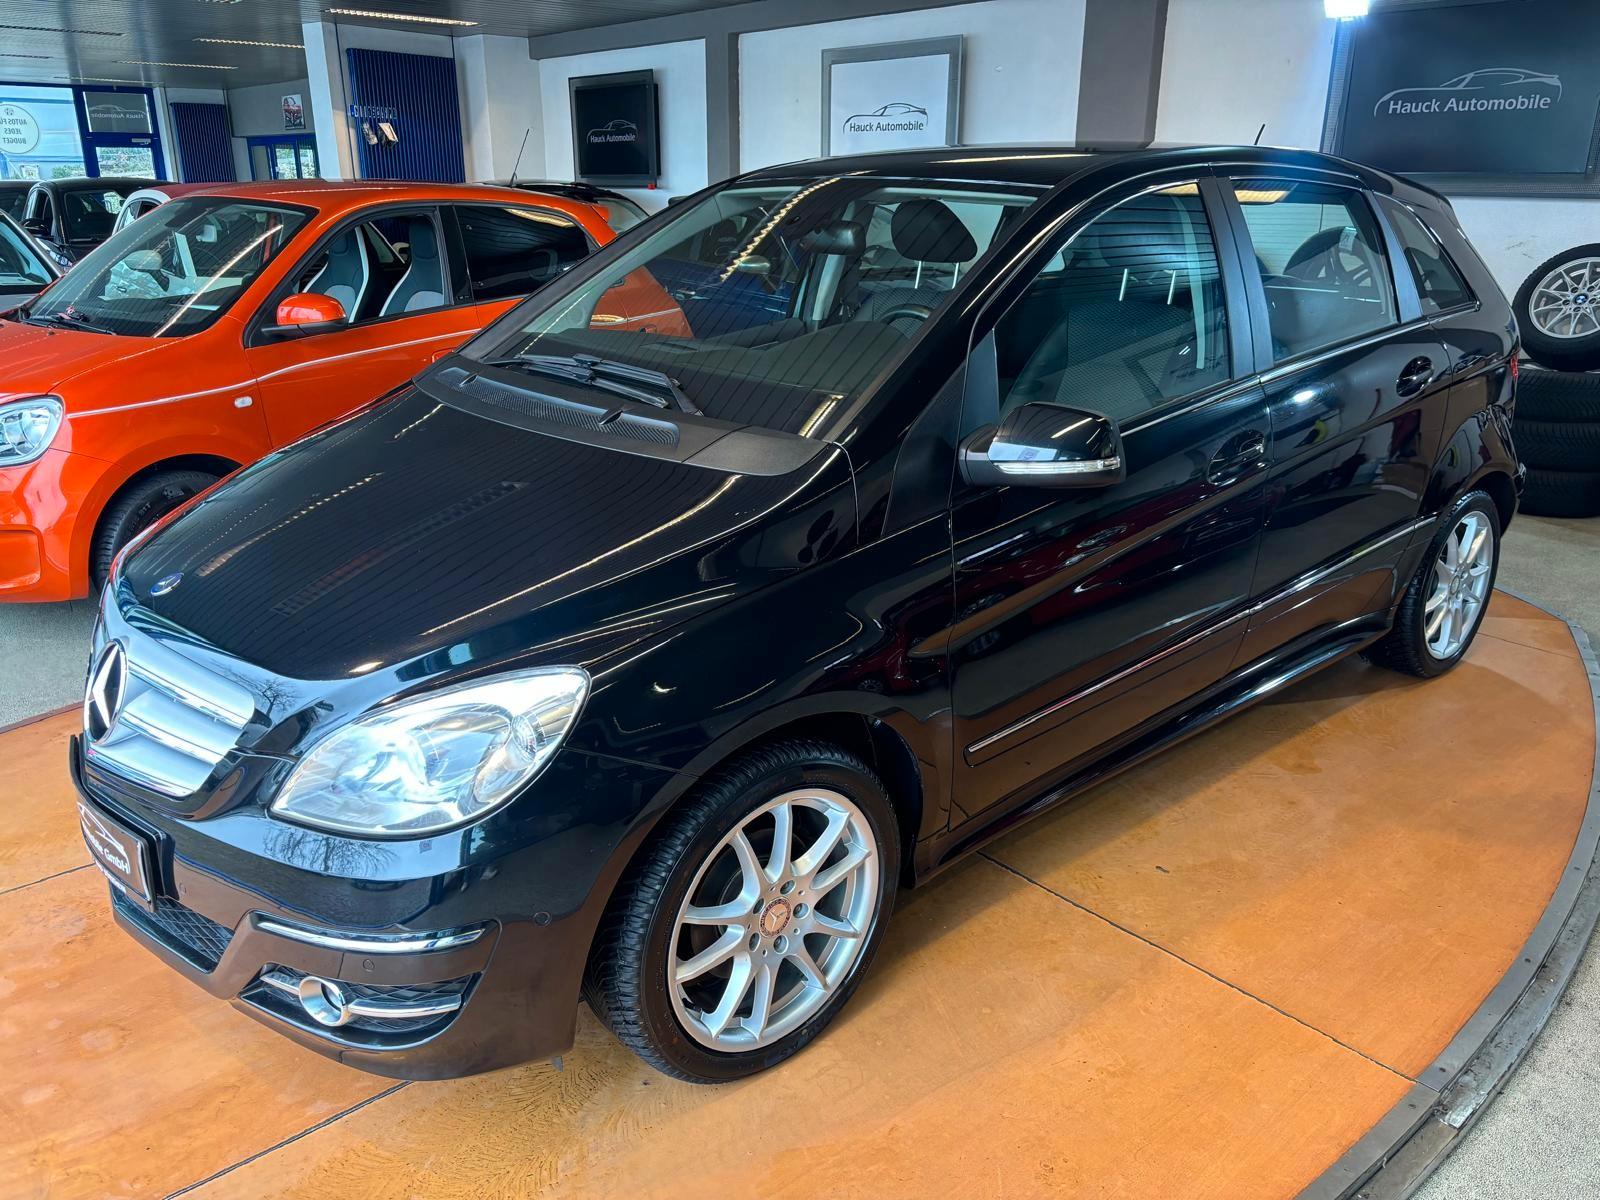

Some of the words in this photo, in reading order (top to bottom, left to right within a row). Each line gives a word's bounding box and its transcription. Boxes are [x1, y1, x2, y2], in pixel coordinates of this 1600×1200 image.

[1388, 98, 1440, 114] Hauck
[1443, 94, 1551, 112] Automobile
[849, 122, 874, 132] Hauck
[875, 121, 924, 131] Automobile
[590, 135, 605, 143] Hauck
[606, 132, 636, 142] Automobile
